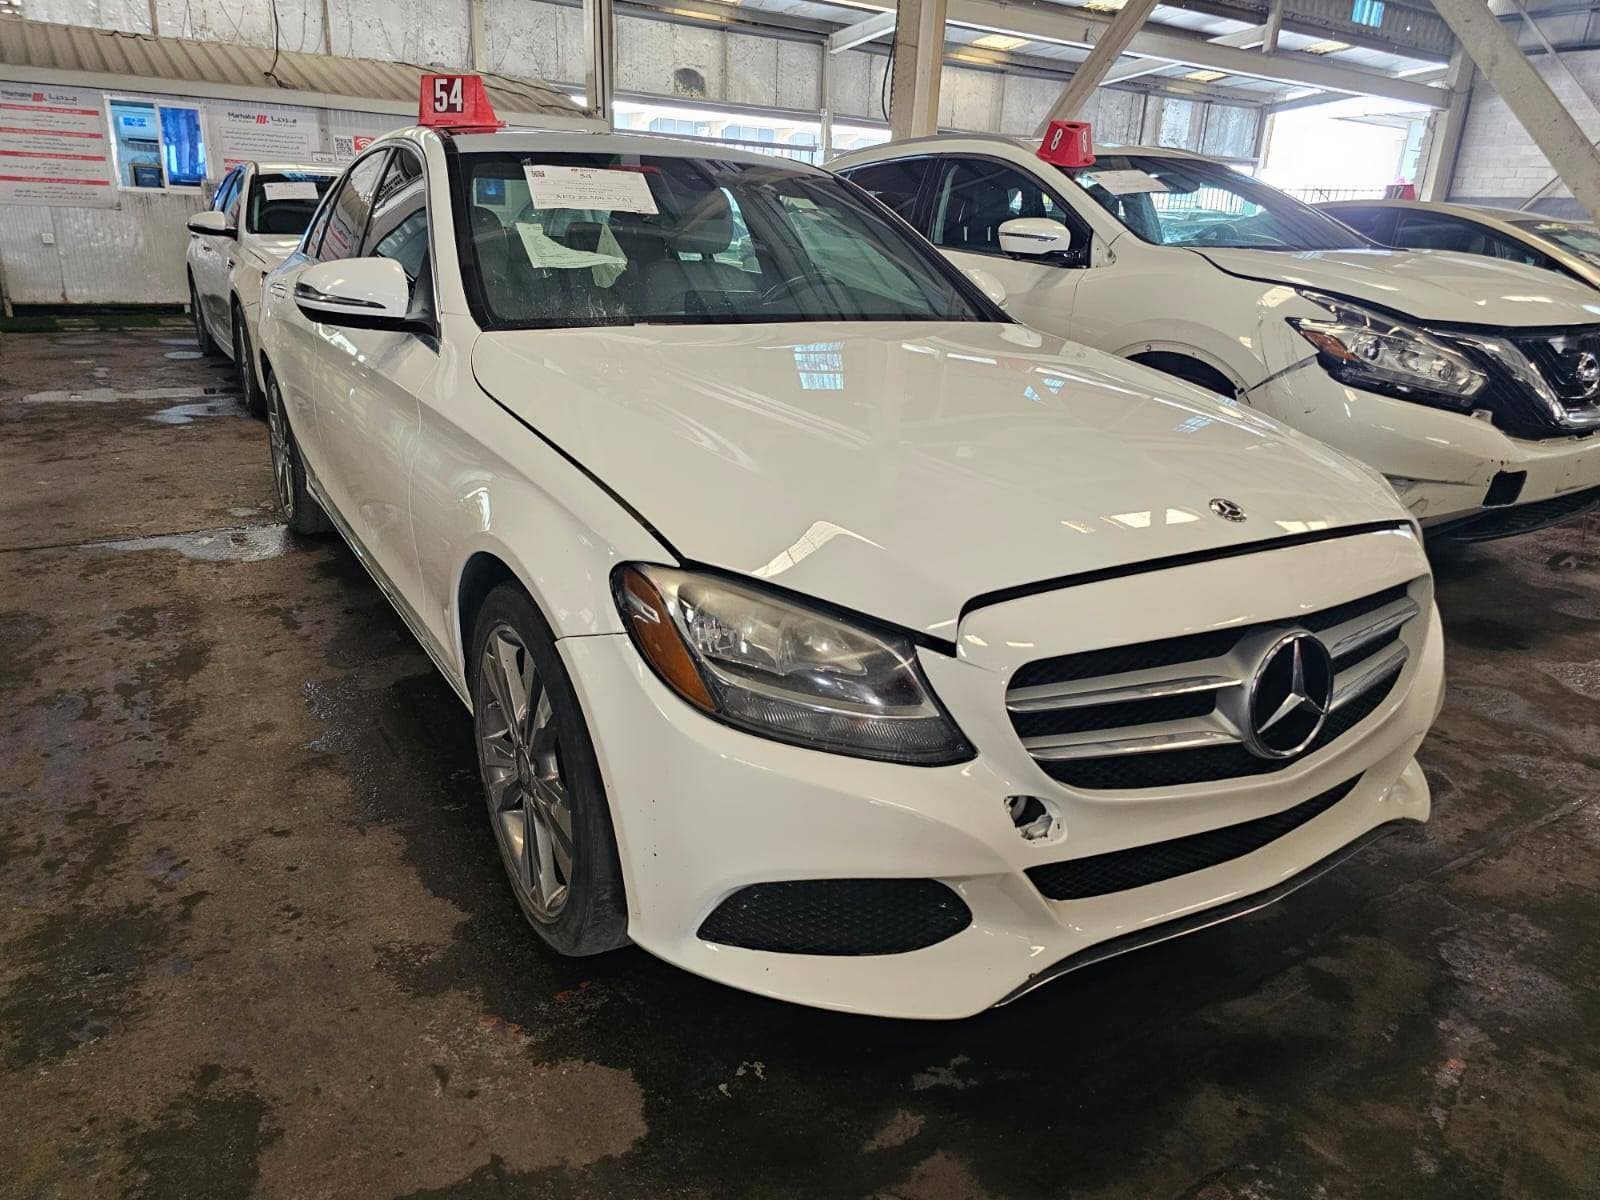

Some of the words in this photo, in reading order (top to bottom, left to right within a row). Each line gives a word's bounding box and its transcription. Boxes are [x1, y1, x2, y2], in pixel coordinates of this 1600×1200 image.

[434, 78, 463, 112] 54
[227, 112, 256, 120] Marhaba
[1051, 128, 1063, 151] 8
